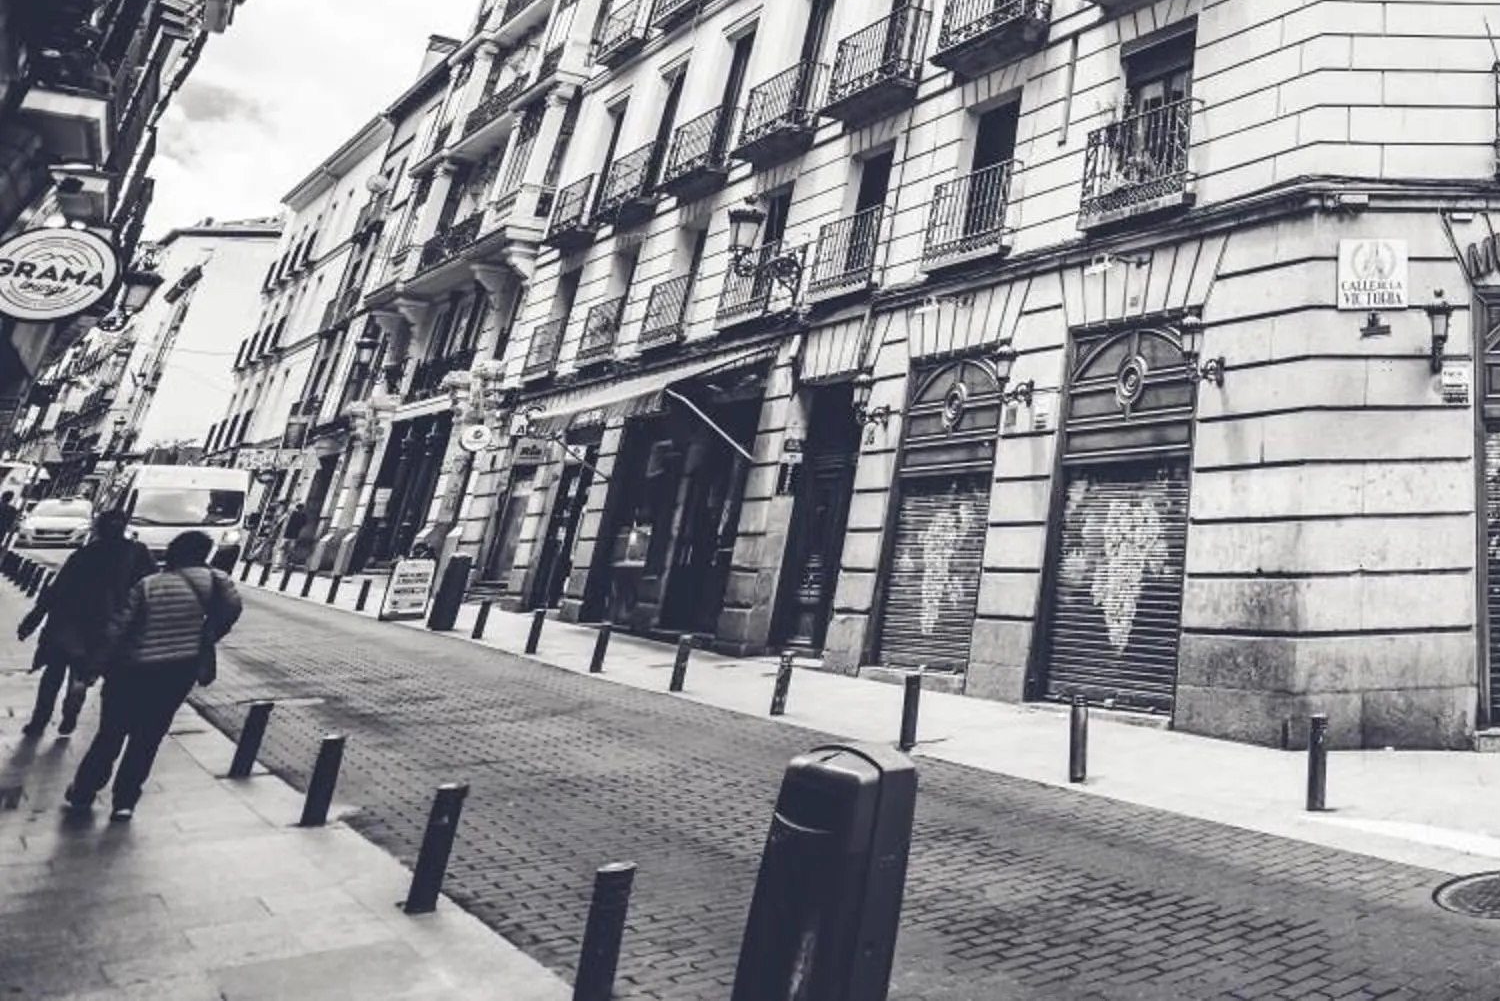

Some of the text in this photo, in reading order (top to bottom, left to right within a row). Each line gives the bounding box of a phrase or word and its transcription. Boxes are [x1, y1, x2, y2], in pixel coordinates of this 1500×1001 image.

[0, 258, 105, 290] GRAMA
[1341, 280, 1376, 292] CALLE
[1390, 280, 1402, 290] LA
[1344, 292, 1403, 305] VICTORIA
